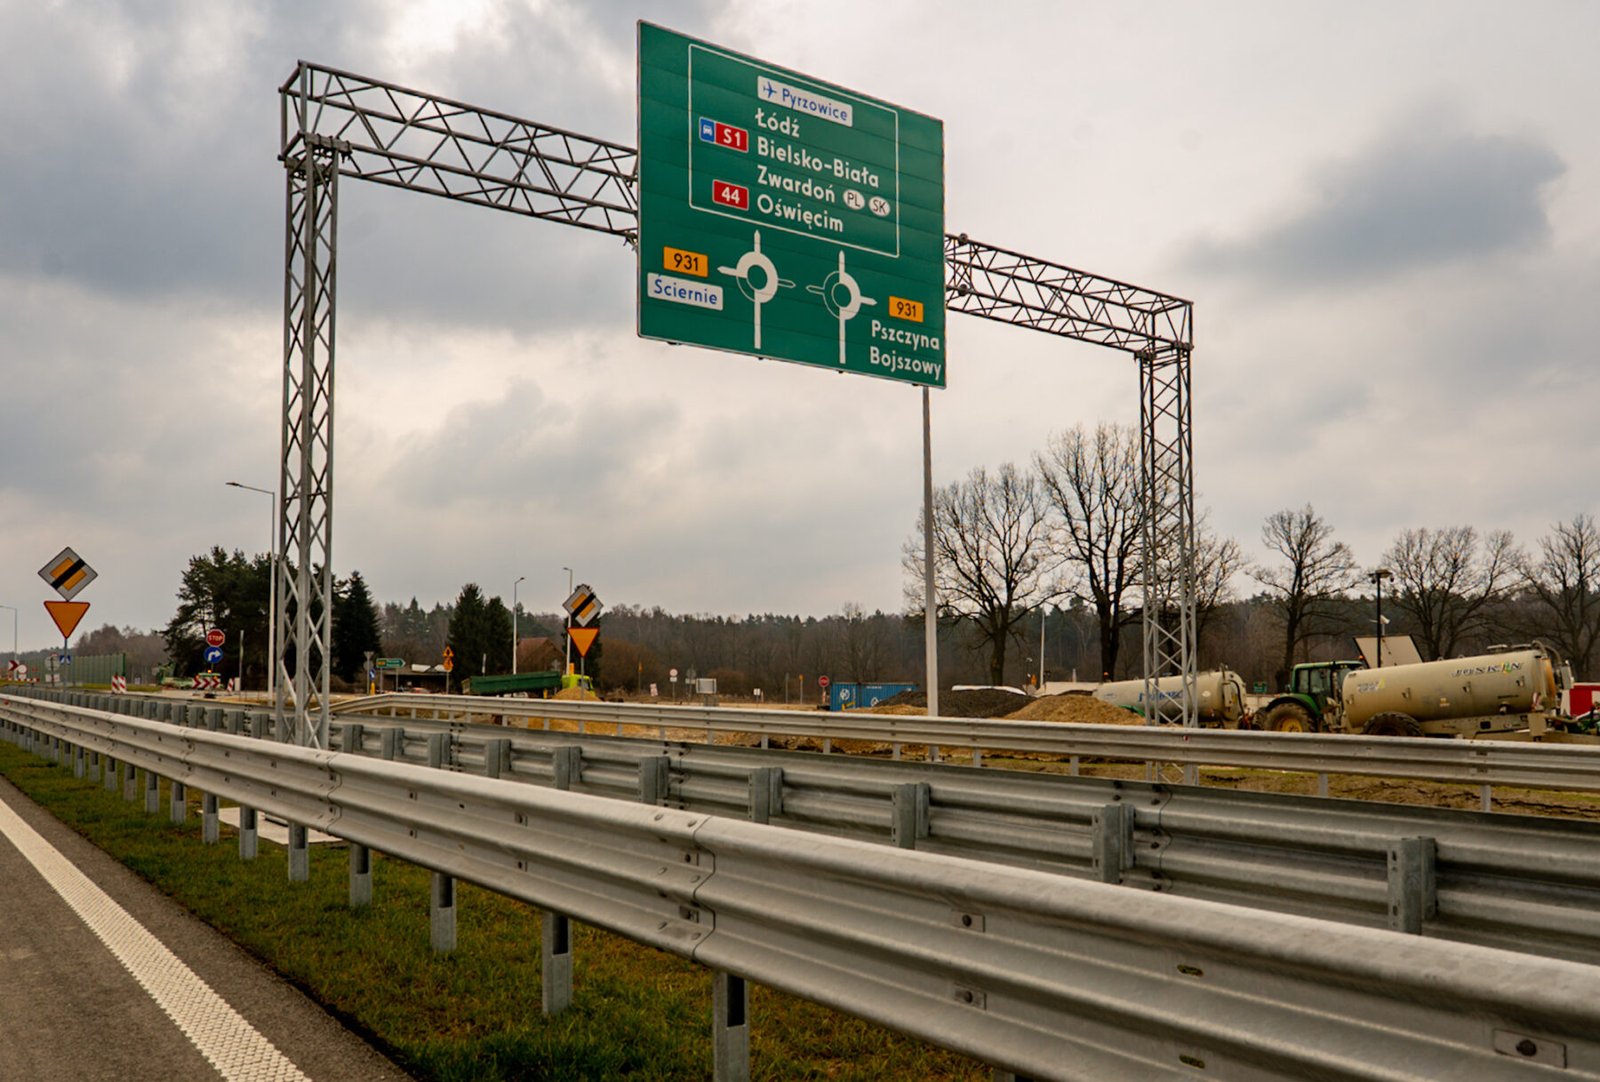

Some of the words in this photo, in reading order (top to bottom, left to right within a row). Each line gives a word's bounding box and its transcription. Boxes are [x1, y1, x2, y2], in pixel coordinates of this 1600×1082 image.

[782, 87, 848, 121] Pyrzowice
[723, 129, 741, 147] S1
[755, 108, 800, 138] Łódź
[757, 136, 879, 188] Bielsko-Biała
[721, 186, 740, 204] 44
[757, 165, 835, 203] Zwardoń
[847, 192, 861, 207] PL
[873, 199, 887, 214] SK
[757, 194, 844, 232] Oświęcim
[674, 252, 699, 272] 931
[896, 301, 917, 318] 931
[871, 319, 940, 351] Pszczyna
[870, 346, 942, 381] Bojszowy
